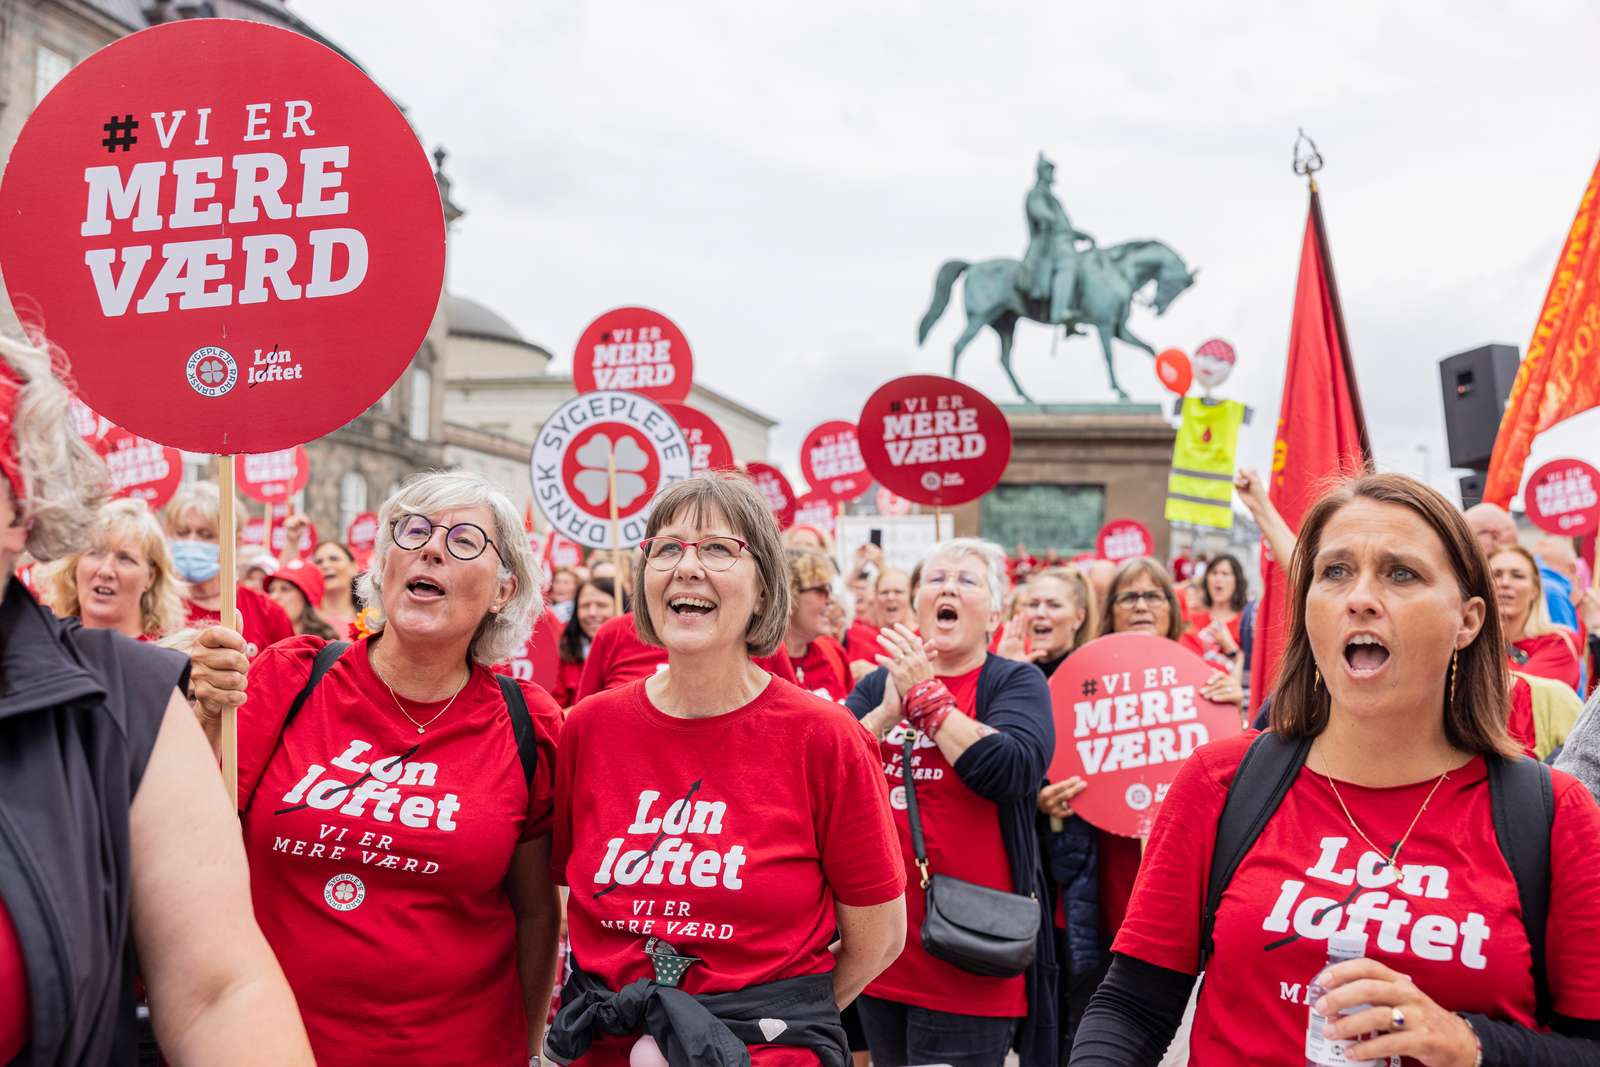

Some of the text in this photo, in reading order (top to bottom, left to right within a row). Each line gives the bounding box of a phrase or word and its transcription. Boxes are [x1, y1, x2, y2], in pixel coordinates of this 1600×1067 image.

[244, 100, 315, 142] ER
[80, 146, 349, 237] MERE
[85, 228, 369, 317] VÆRD
[639, 326, 662, 341] ER
[189, 347, 234, 369] SYGEPLEJE
[592, 340, 671, 367] MERE
[592, 363, 675, 390] VÆRD
[937, 395, 964, 410] ER
[543, 397, 684, 460] SYGEPLEJE
[883, 408, 979, 441] MERE
[884, 433, 986, 466] VÆRD
[537, 464, 606, 543] DANSK
[1144, 666, 1178, 688] ER
[1073, 685, 1198, 738] MERE
[319, 823, 394, 850] VI ER
[272, 836, 440, 876] MERE VÆRD
[633, 900, 691, 917] VI ER
[666, 920, 734, 940] VÆRD
